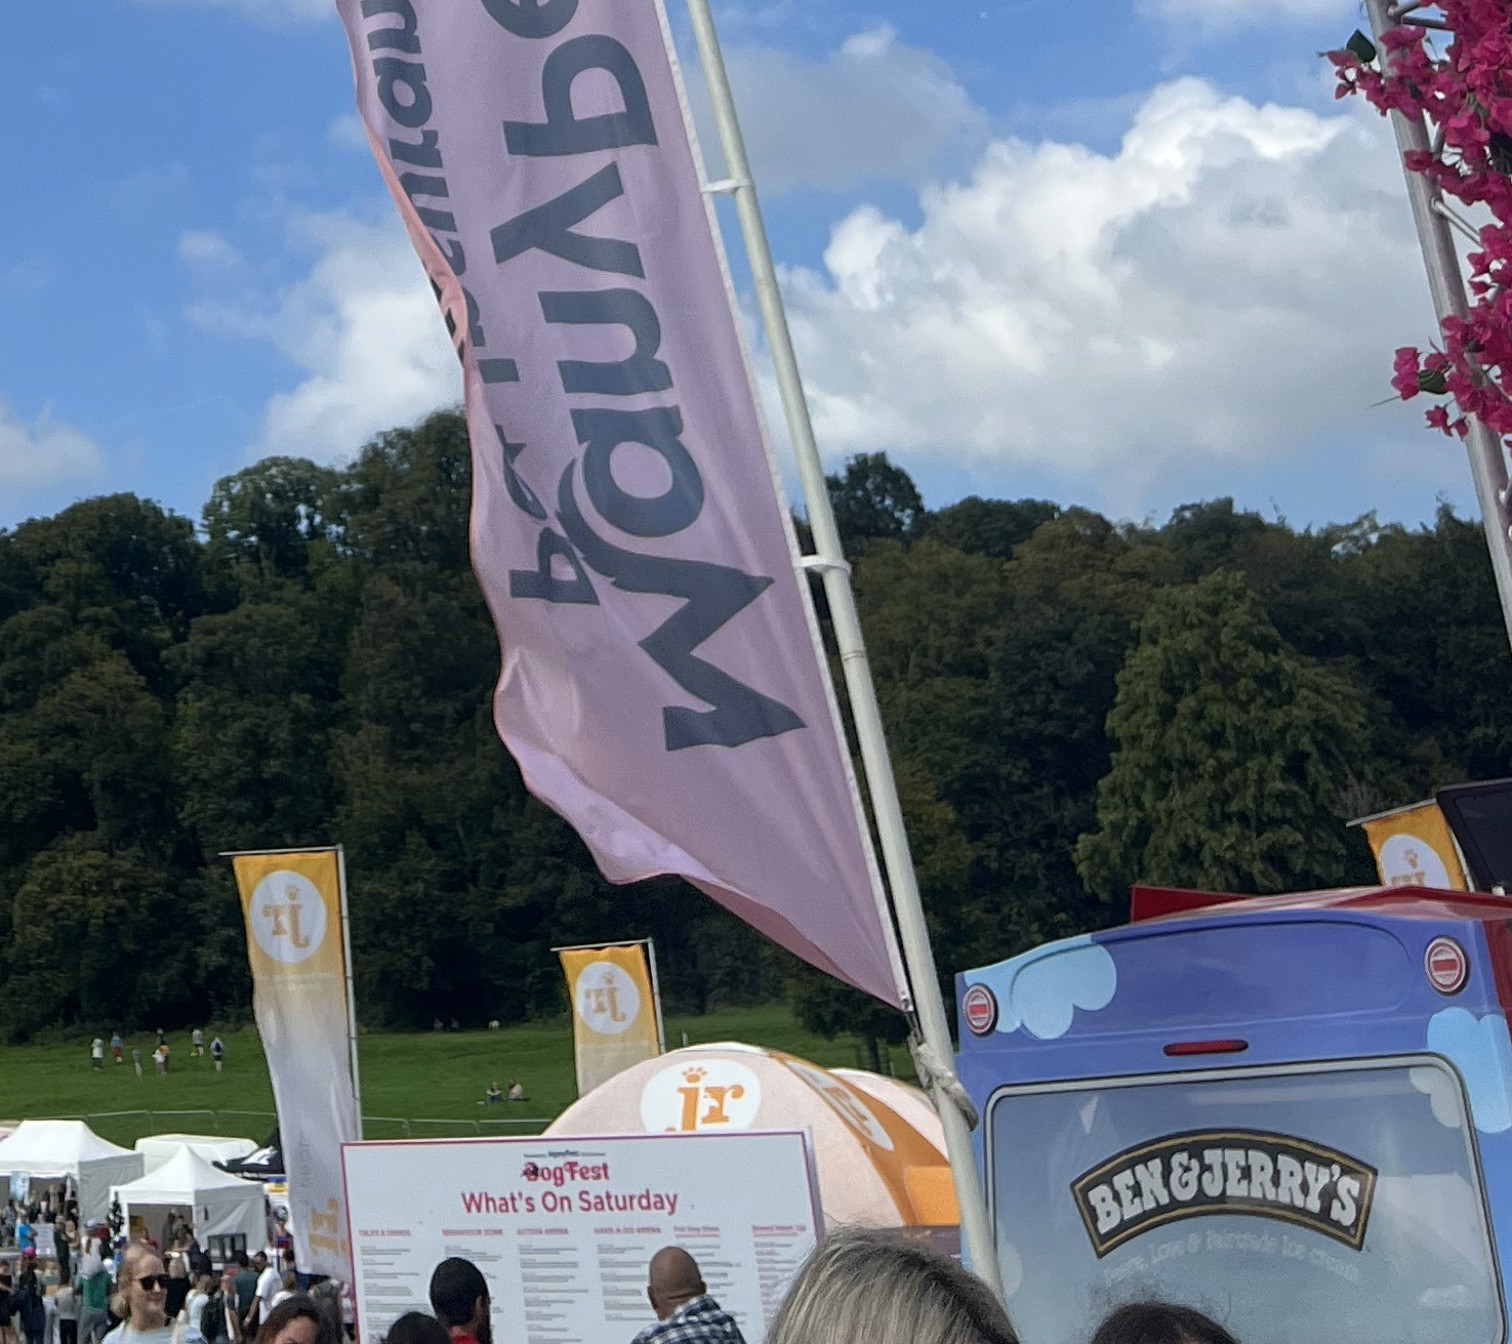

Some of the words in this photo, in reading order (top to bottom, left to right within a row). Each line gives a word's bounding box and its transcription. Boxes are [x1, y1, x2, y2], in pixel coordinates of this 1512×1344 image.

[461, 1191, 535, 1214] What's
[541, 1191, 573, 1213] On
[578, 1188, 679, 1216] Saturday
